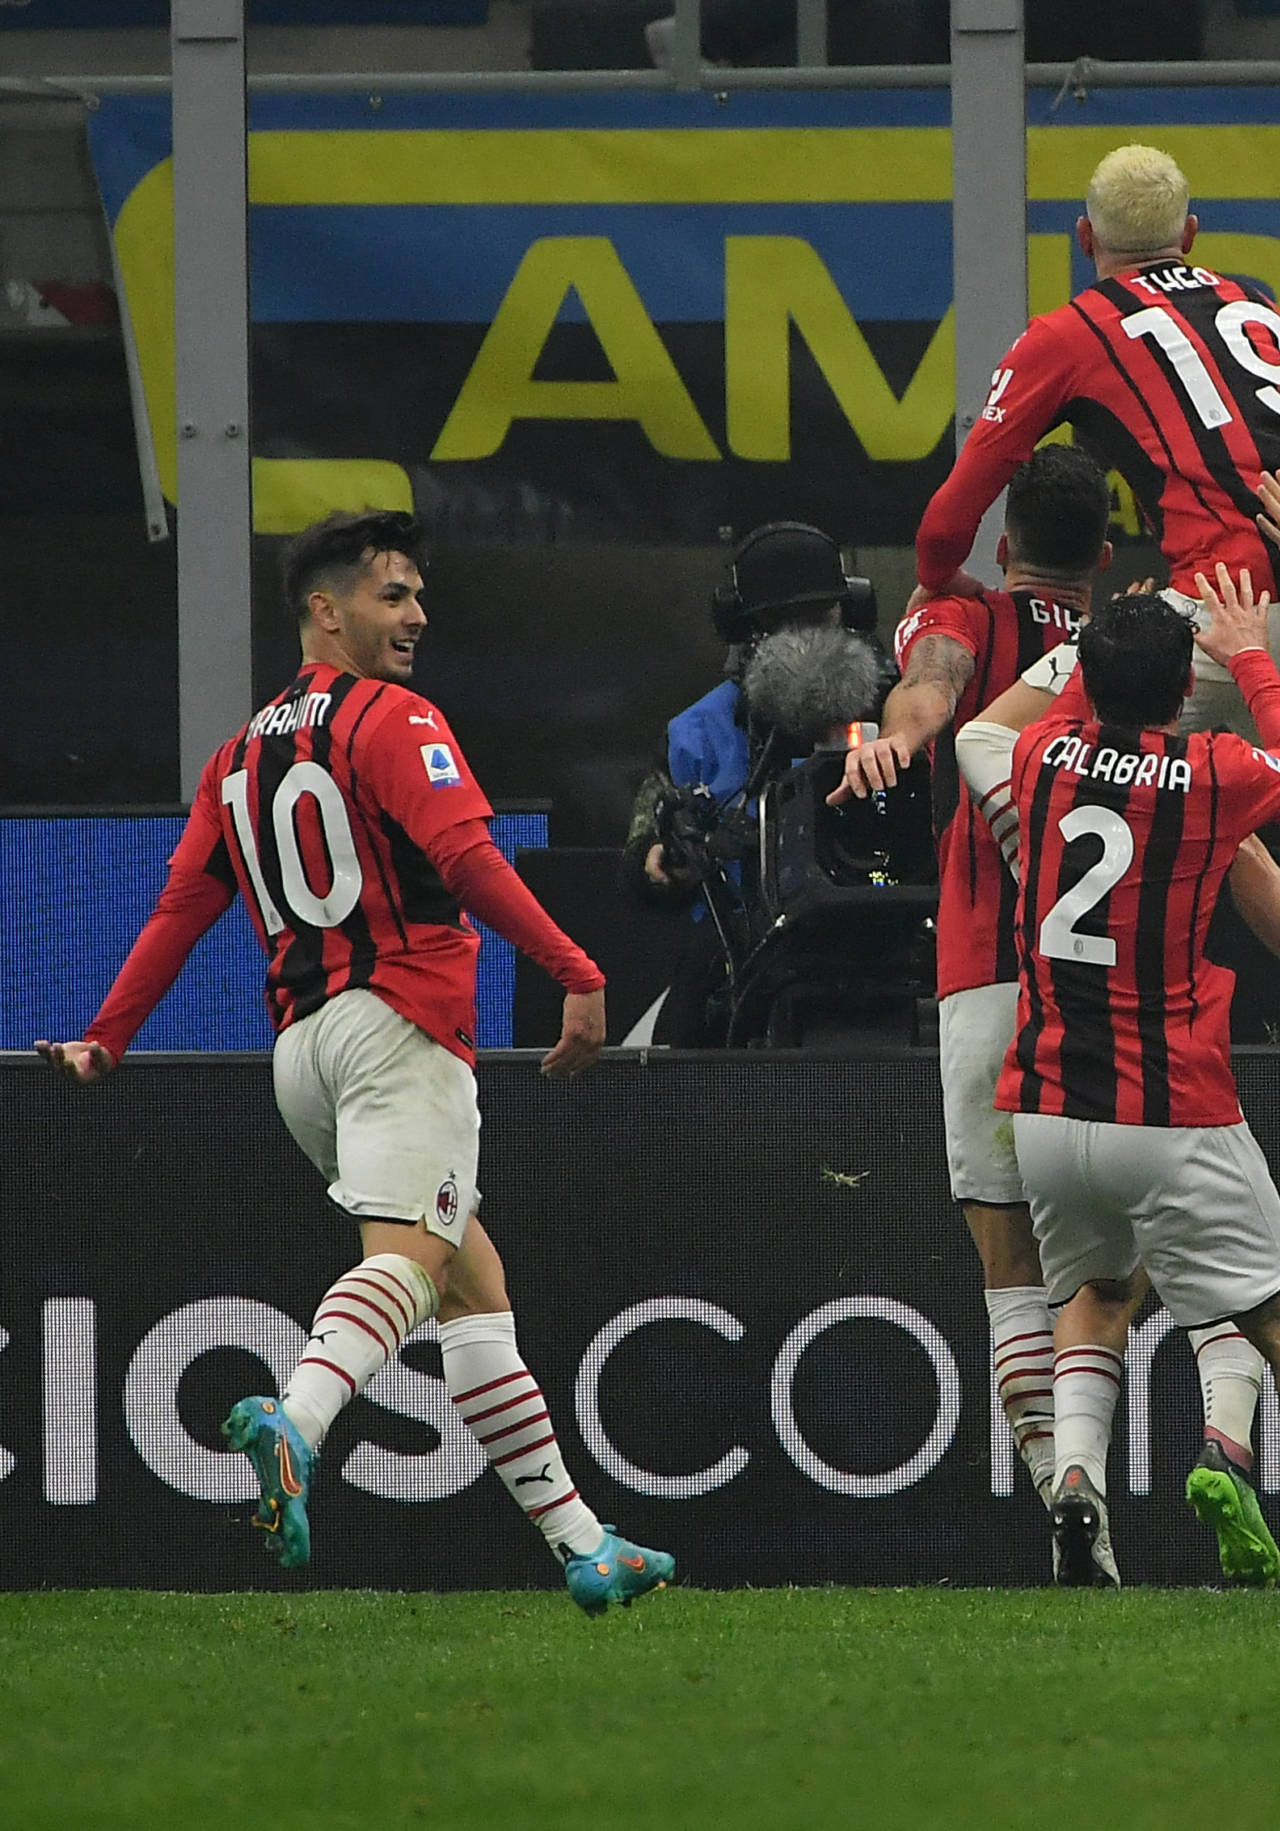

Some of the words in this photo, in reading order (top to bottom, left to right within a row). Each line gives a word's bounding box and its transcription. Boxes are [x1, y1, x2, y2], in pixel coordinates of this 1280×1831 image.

[1130, 266, 1220, 295] THEO
[1041, 735, 1192, 793] CALABRIA
[222, 761, 363, 937] 10
[1038, 804, 1134, 967] 2
